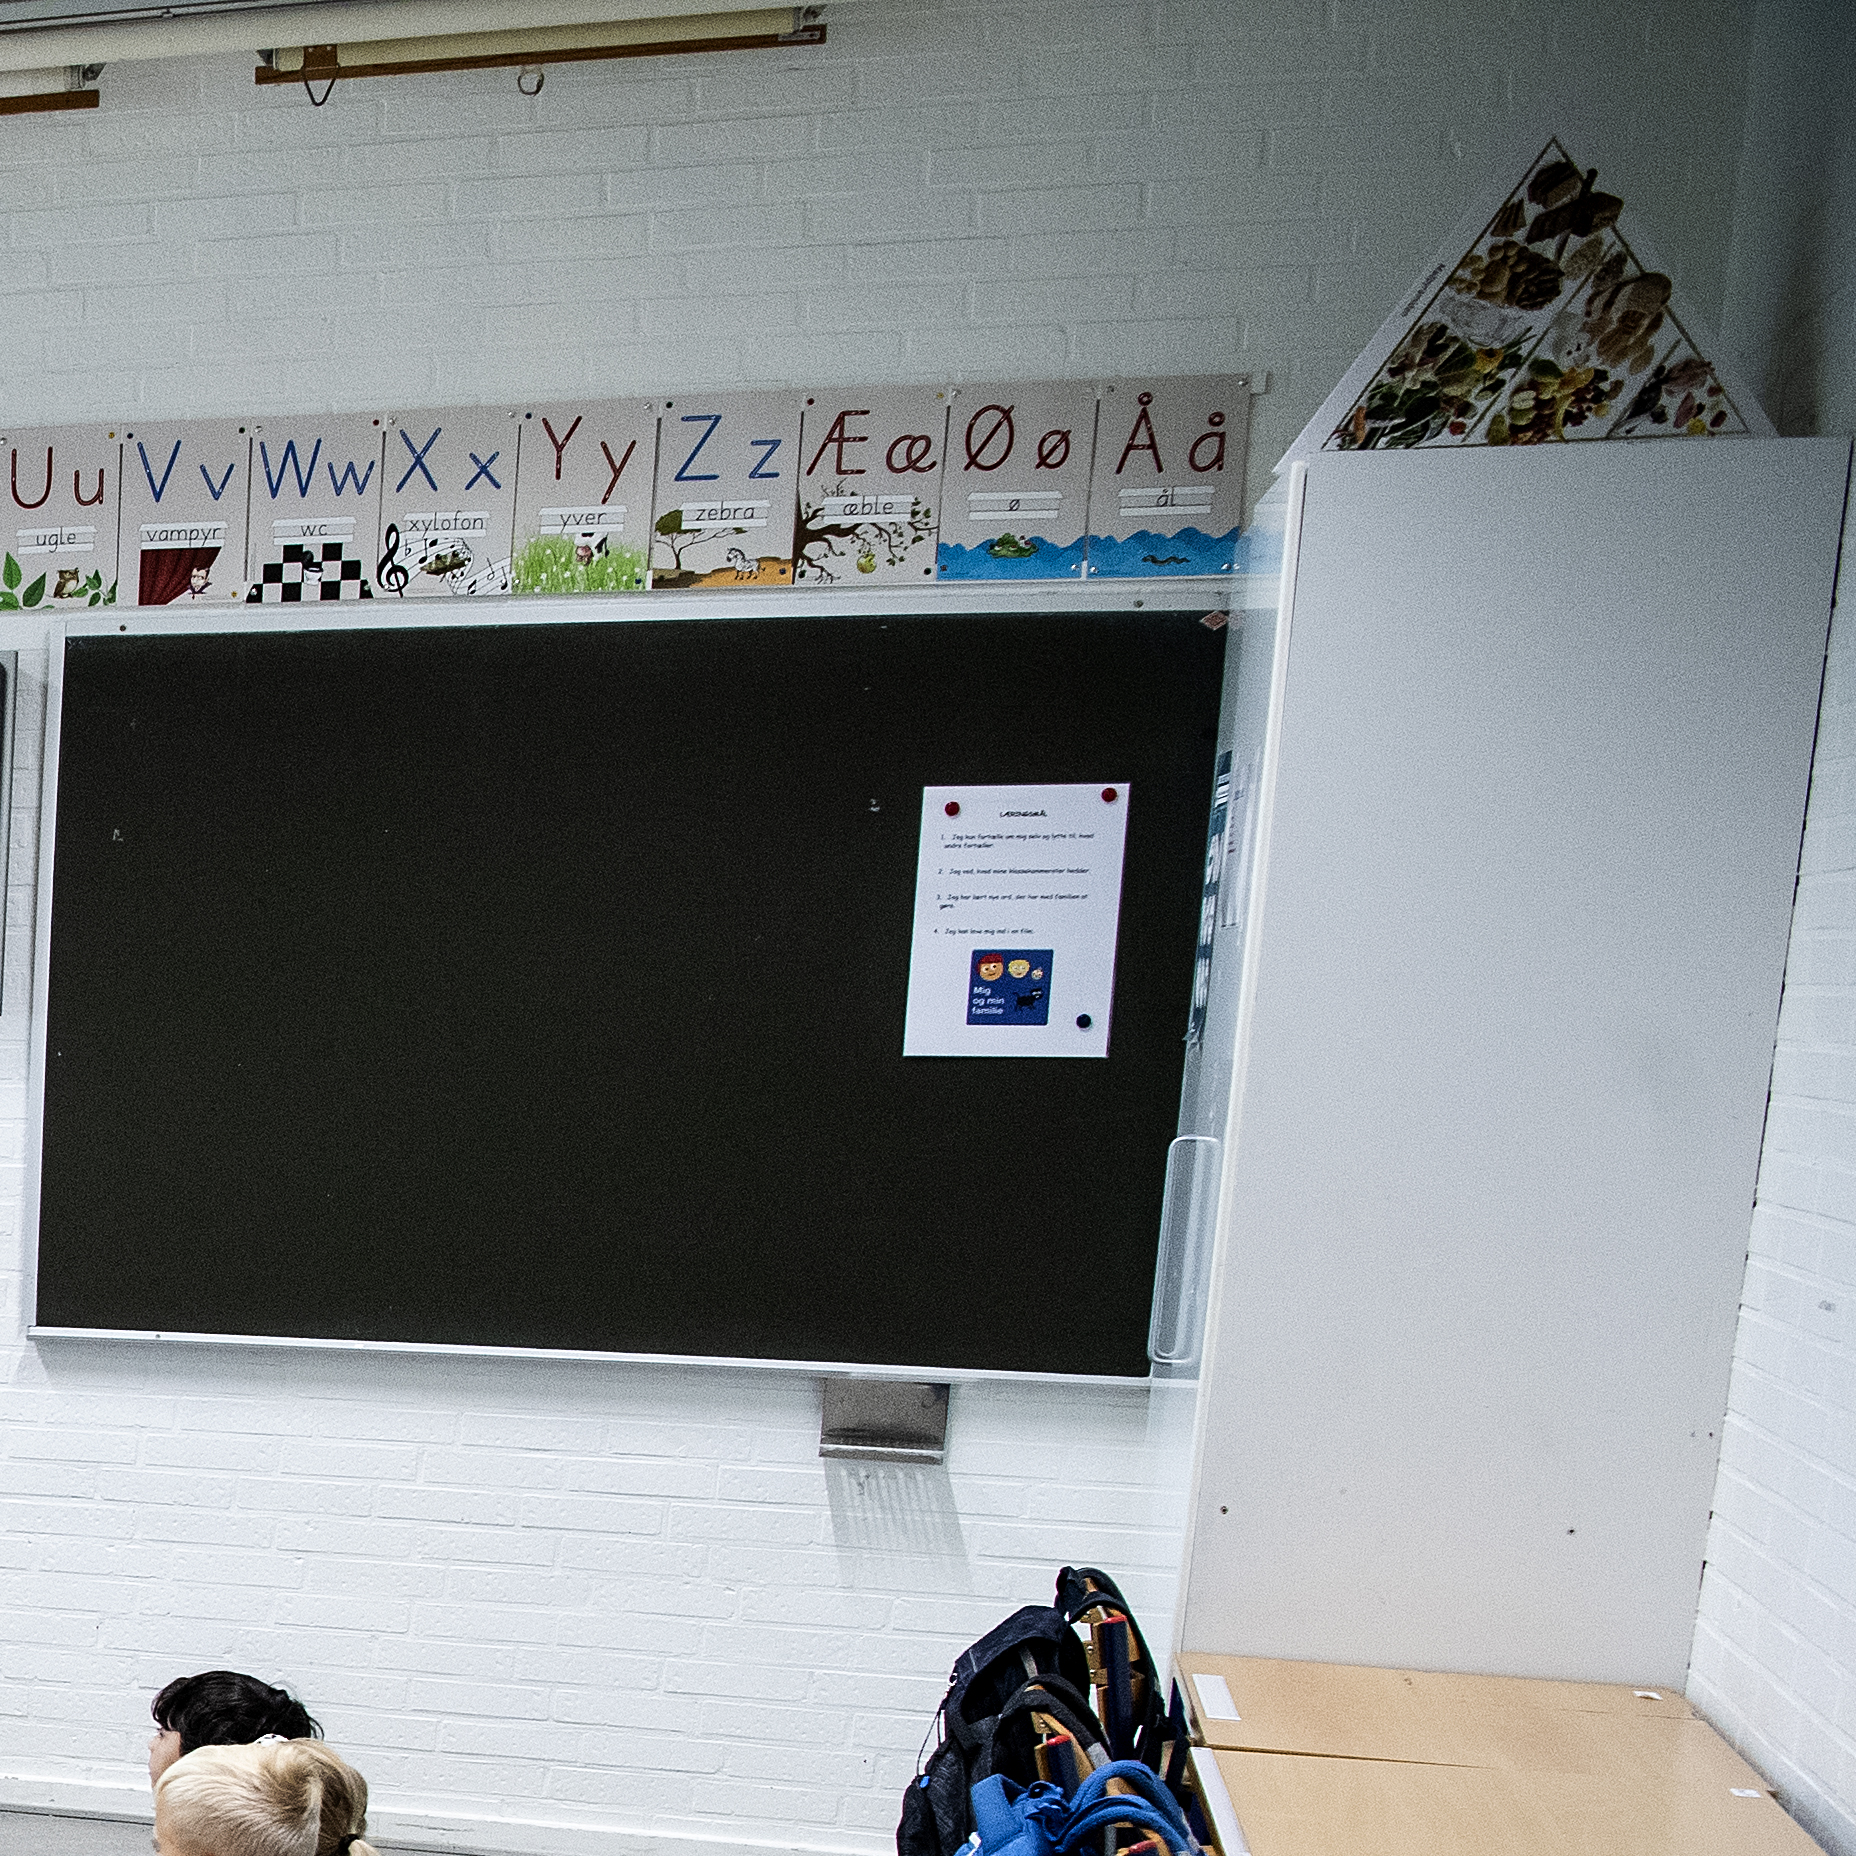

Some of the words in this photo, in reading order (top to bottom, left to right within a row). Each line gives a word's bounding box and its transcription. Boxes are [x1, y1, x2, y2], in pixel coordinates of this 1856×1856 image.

[842, 495, 894, 516] æble
[1008, 498, 1020, 512] ø
[1156, 486, 1176, 508] ål
[694, 500, 756, 522] zebra
[300, 523, 328, 536] wc
[408, 511, 484, 540] xylofon
[559, 511, 608, 535] yver
[36, 526, 77, 553] ugle
[146, 524, 221, 546] vampyr
[972, 997, 986, 1006] og
[973, 986, 991, 996] Mig
